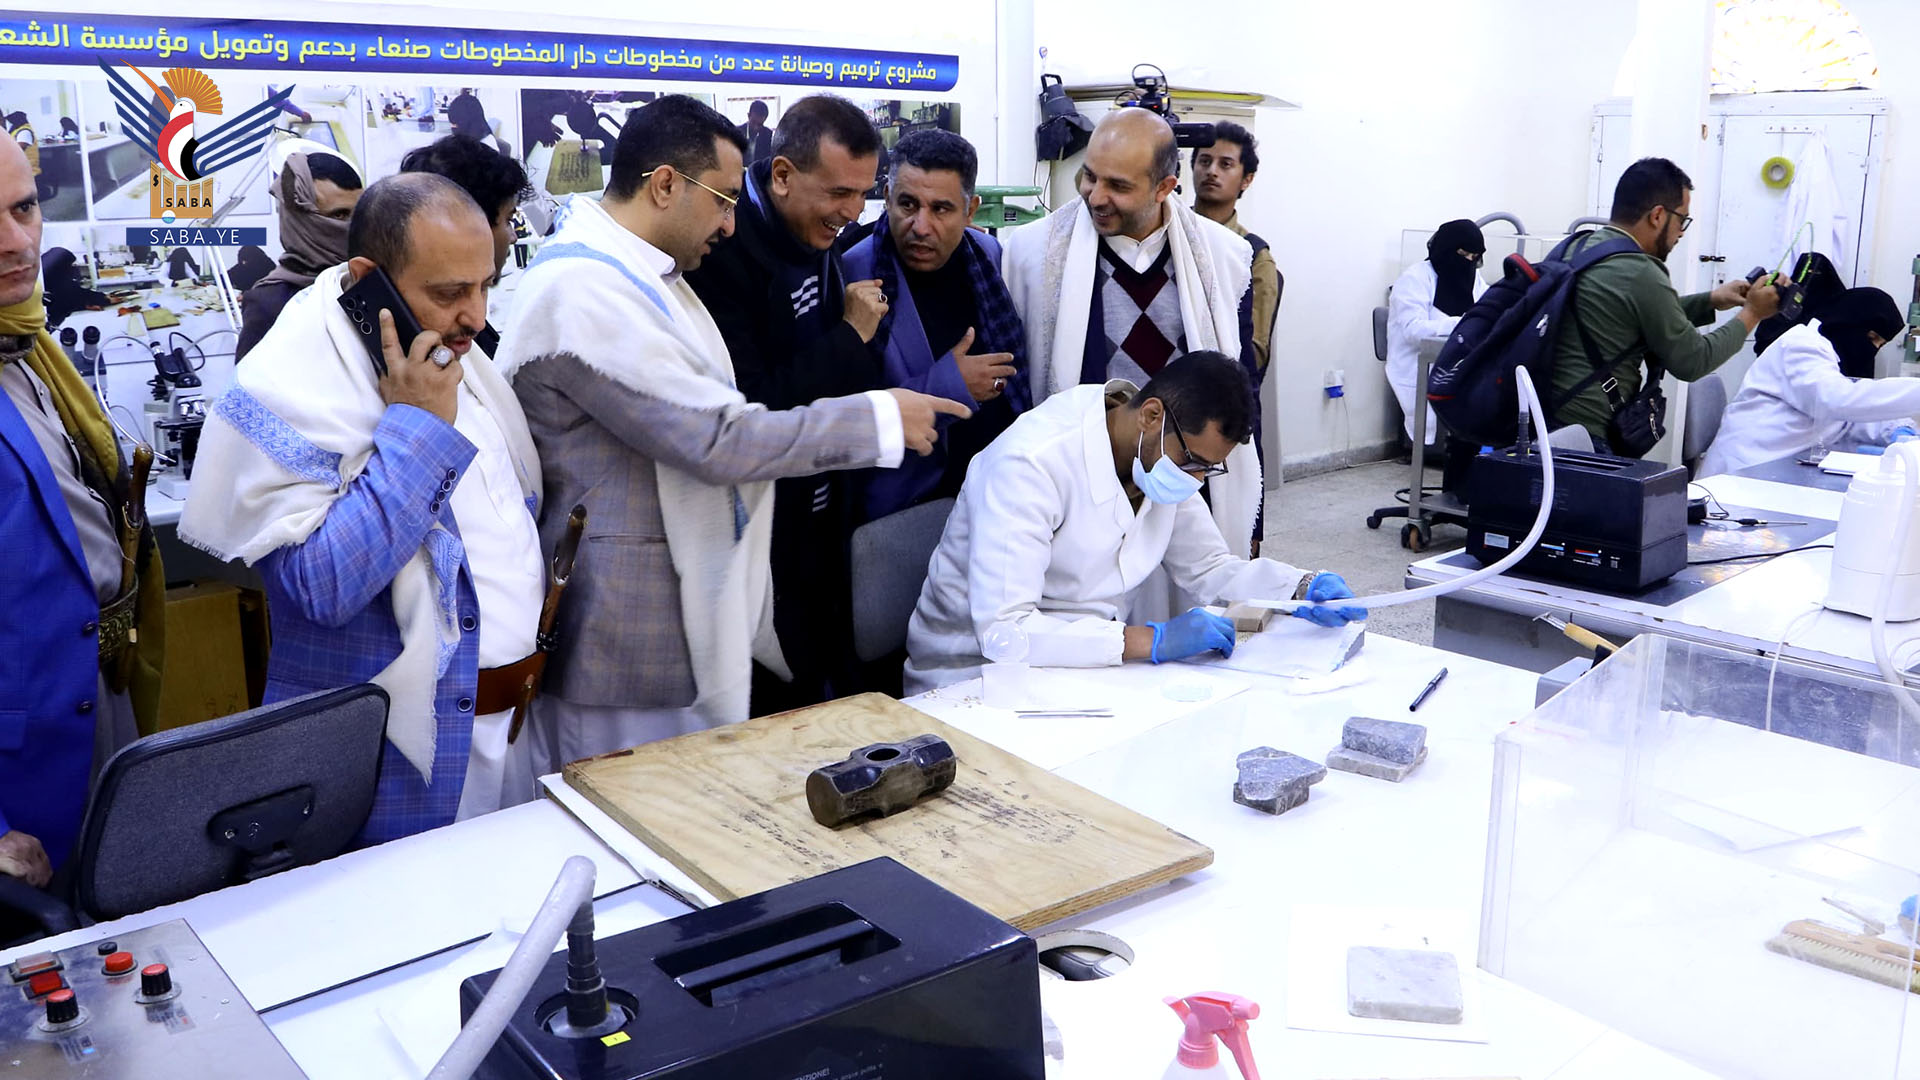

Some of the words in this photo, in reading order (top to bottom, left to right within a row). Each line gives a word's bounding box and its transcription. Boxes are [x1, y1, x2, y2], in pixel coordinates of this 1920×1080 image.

[81, 26, 189, 58] مؤسسة
[200, 30, 289, 62] وتمويل
[299, 40, 356, 64] بدعم
[366, 36, 432, 59] صنعاء
[440, 39, 565, 67] المخطوطات
[570, 44, 597, 70] دار
[604, 46, 702, 73] مخطوطات
[709, 54, 736, 75] من
[742, 56, 775, 72] عدد
[781, 55, 834, 80] وصيانة
[839, 60, 881, 82] ترميم
[886, 60, 937, 85] مشروع
